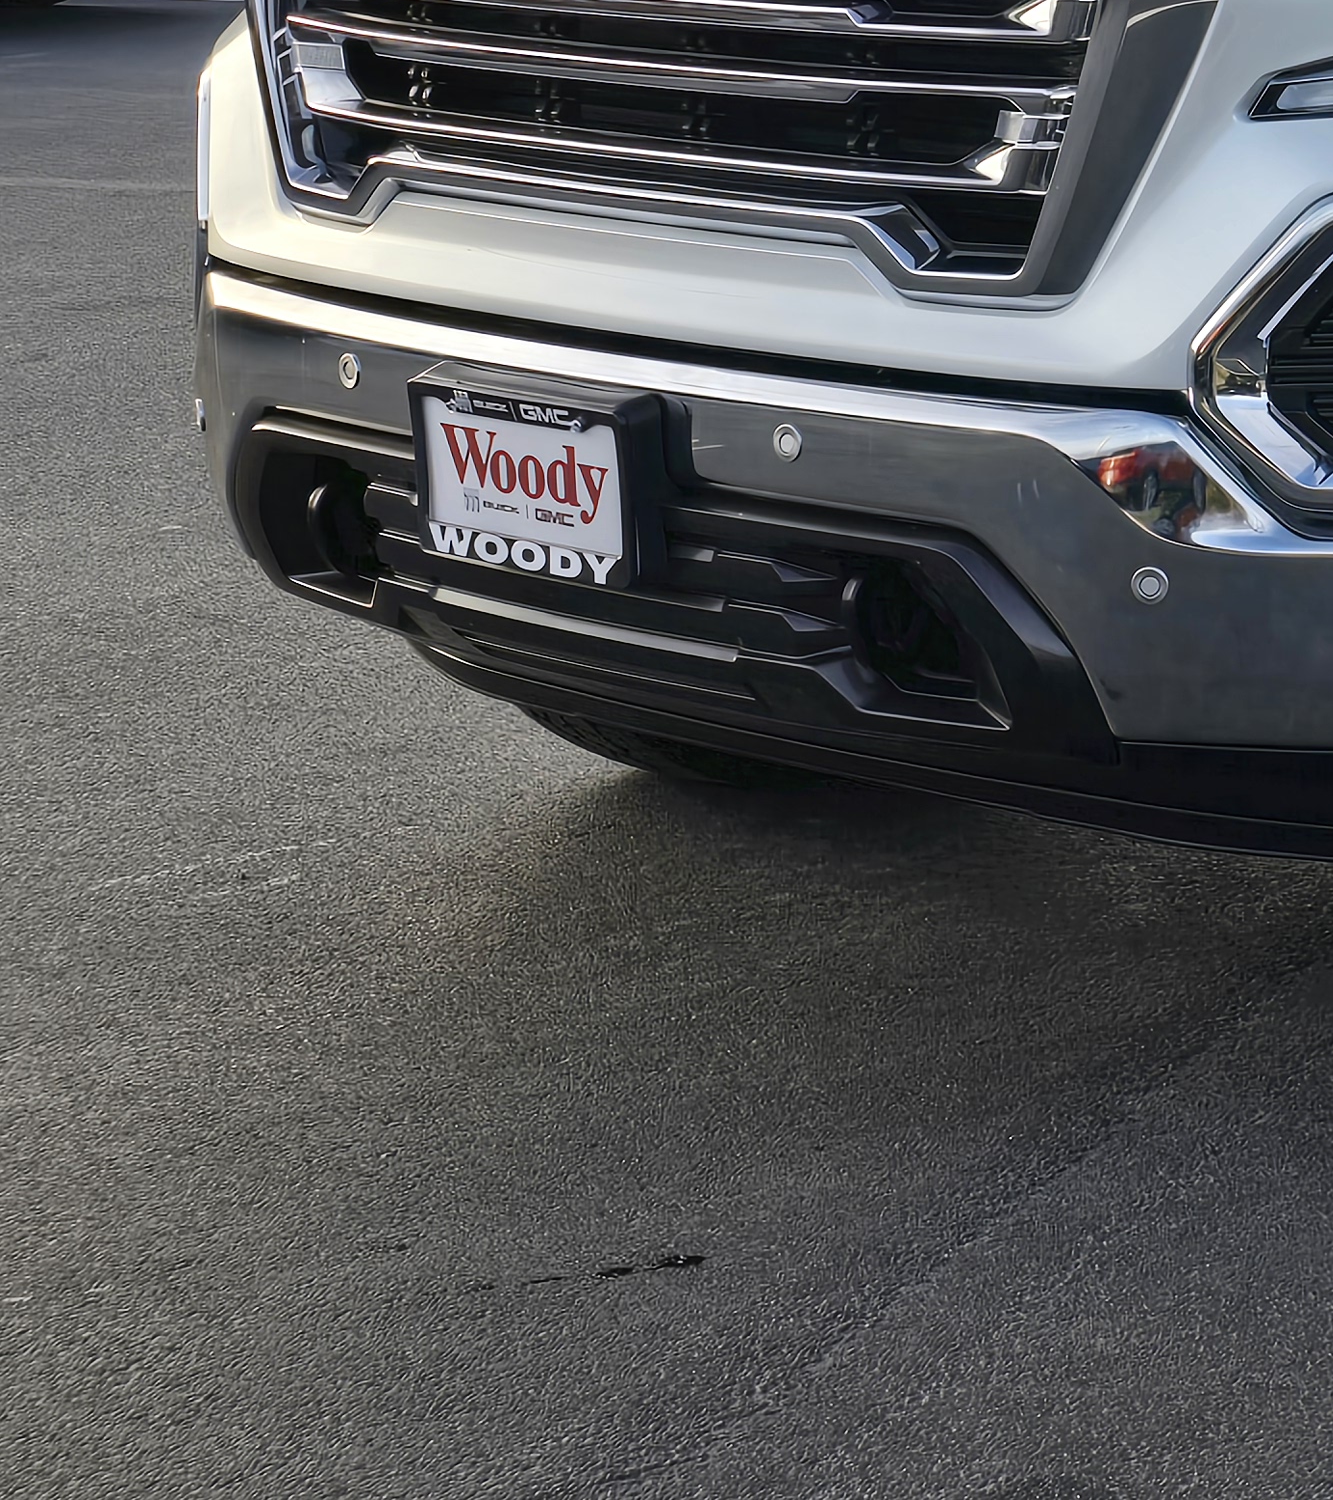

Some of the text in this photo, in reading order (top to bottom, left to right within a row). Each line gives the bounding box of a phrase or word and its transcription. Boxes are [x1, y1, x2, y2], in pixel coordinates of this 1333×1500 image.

[519, 403, 575, 427] GMC
[440, 422, 609, 525] Woody
[535, 508, 575, 528] GMC
[429, 524, 618, 586] WOODY
